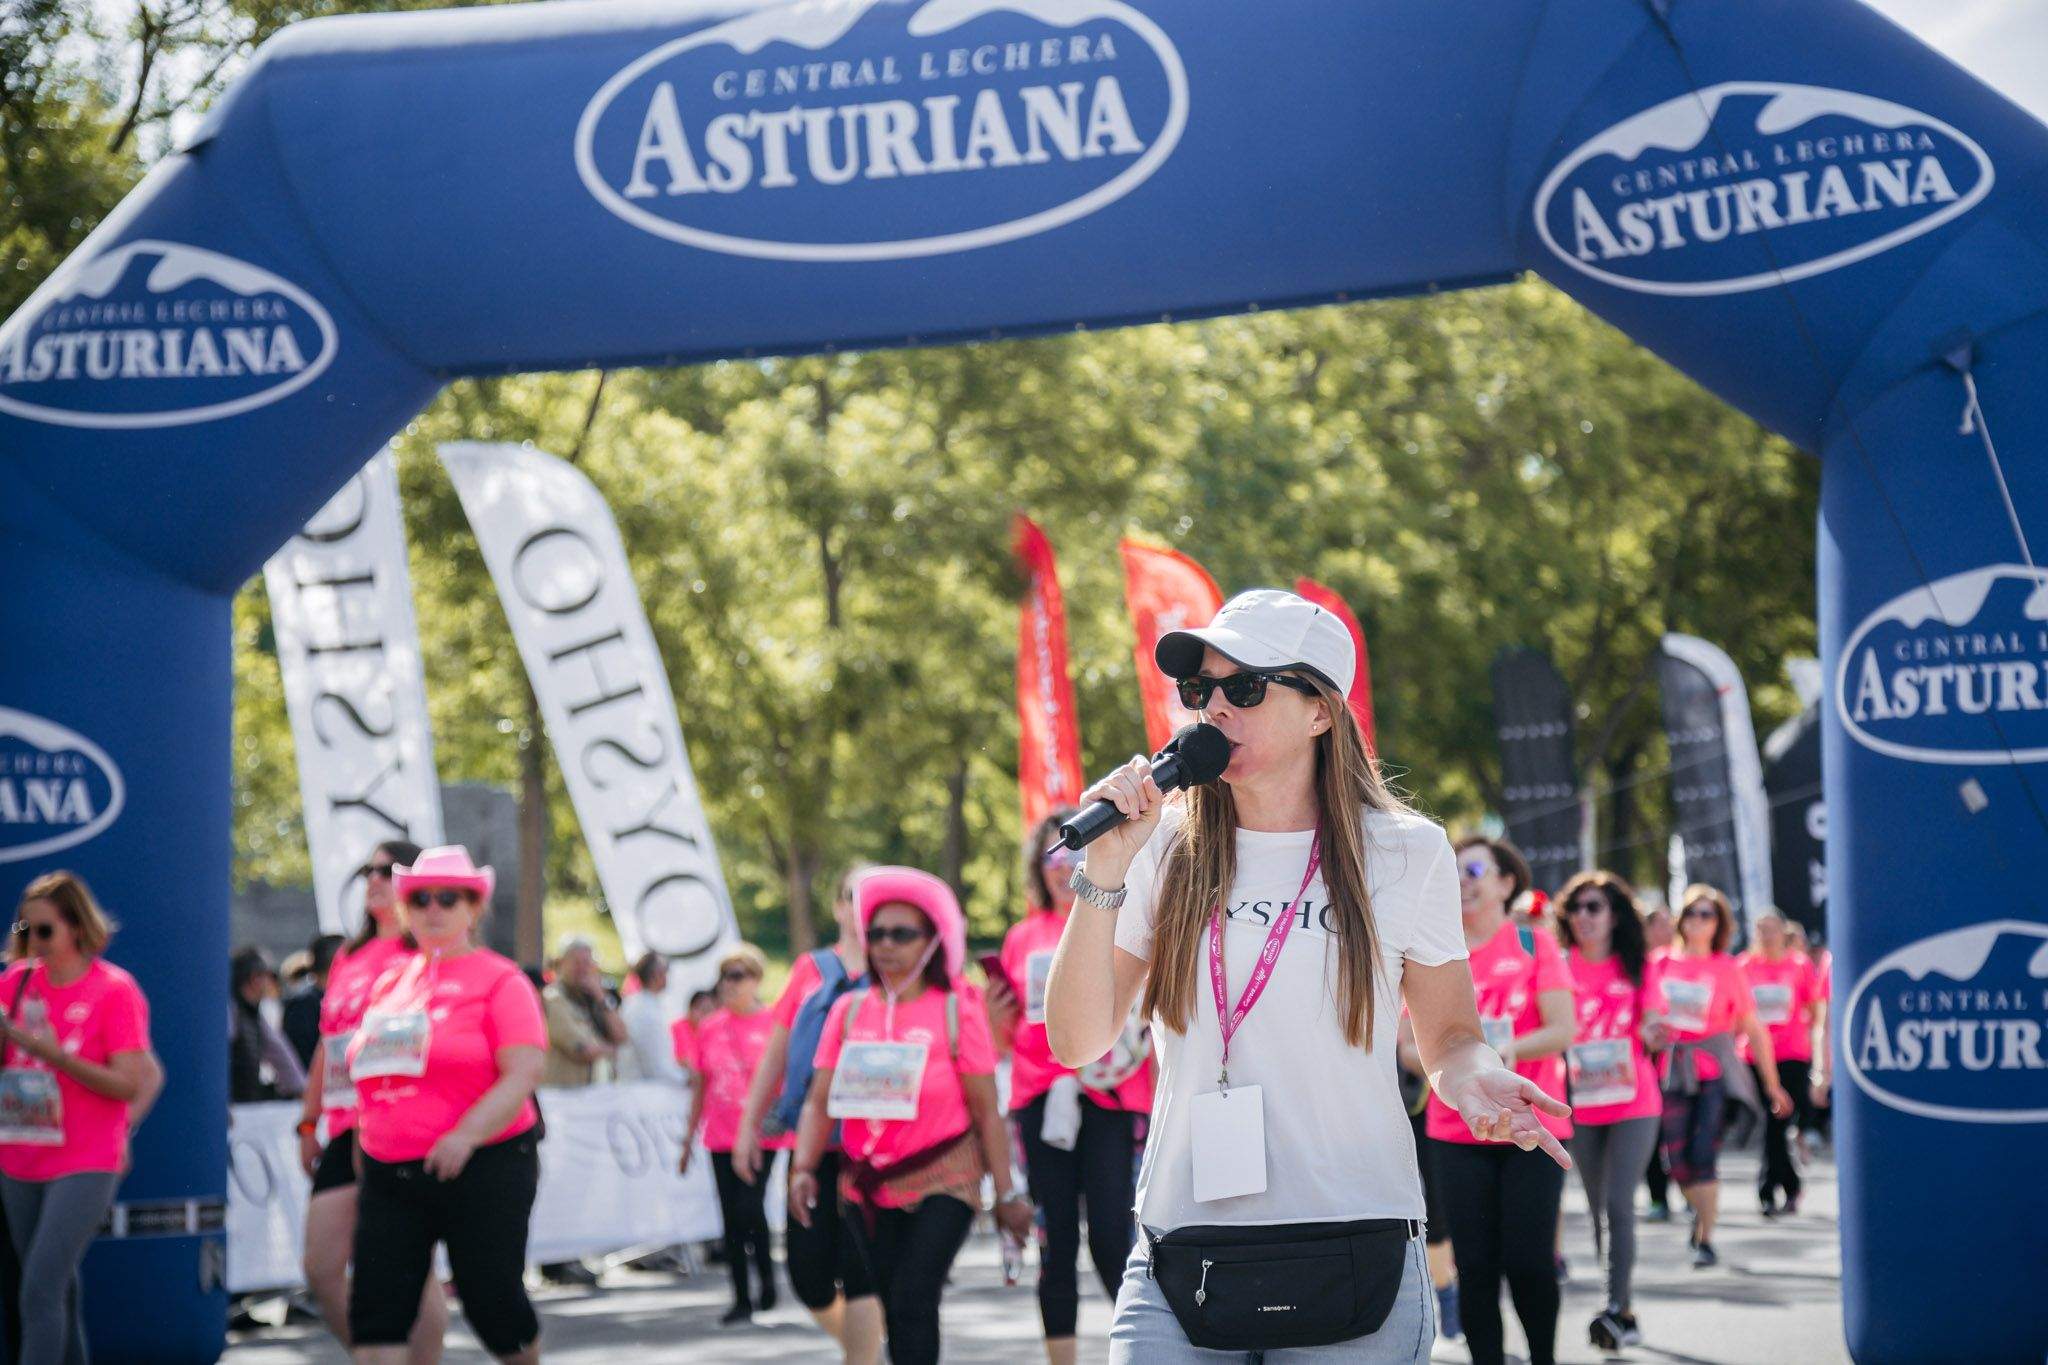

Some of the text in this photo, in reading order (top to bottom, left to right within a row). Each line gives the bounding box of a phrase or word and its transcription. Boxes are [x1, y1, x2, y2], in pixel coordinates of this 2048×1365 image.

[713, 34, 1118, 99] CENTRAL LECHERA
[623, 76, 1145, 198] ASTURIANA
[1612, 131, 1935, 196] CENTRAL LECHERA
[1573, 155, 1958, 262] ASTURIANA
[156, 299, 288, 323] LECHERA
[0, 324, 307, 384] ASTURIANA
[1895, 631, 2025, 660] CENTRAL
[1853, 647, 2048, 721] ASTUR
[1859, 994, 2048, 1071] ASTUR
[1900, 989, 2028, 1012] CENTRAL
